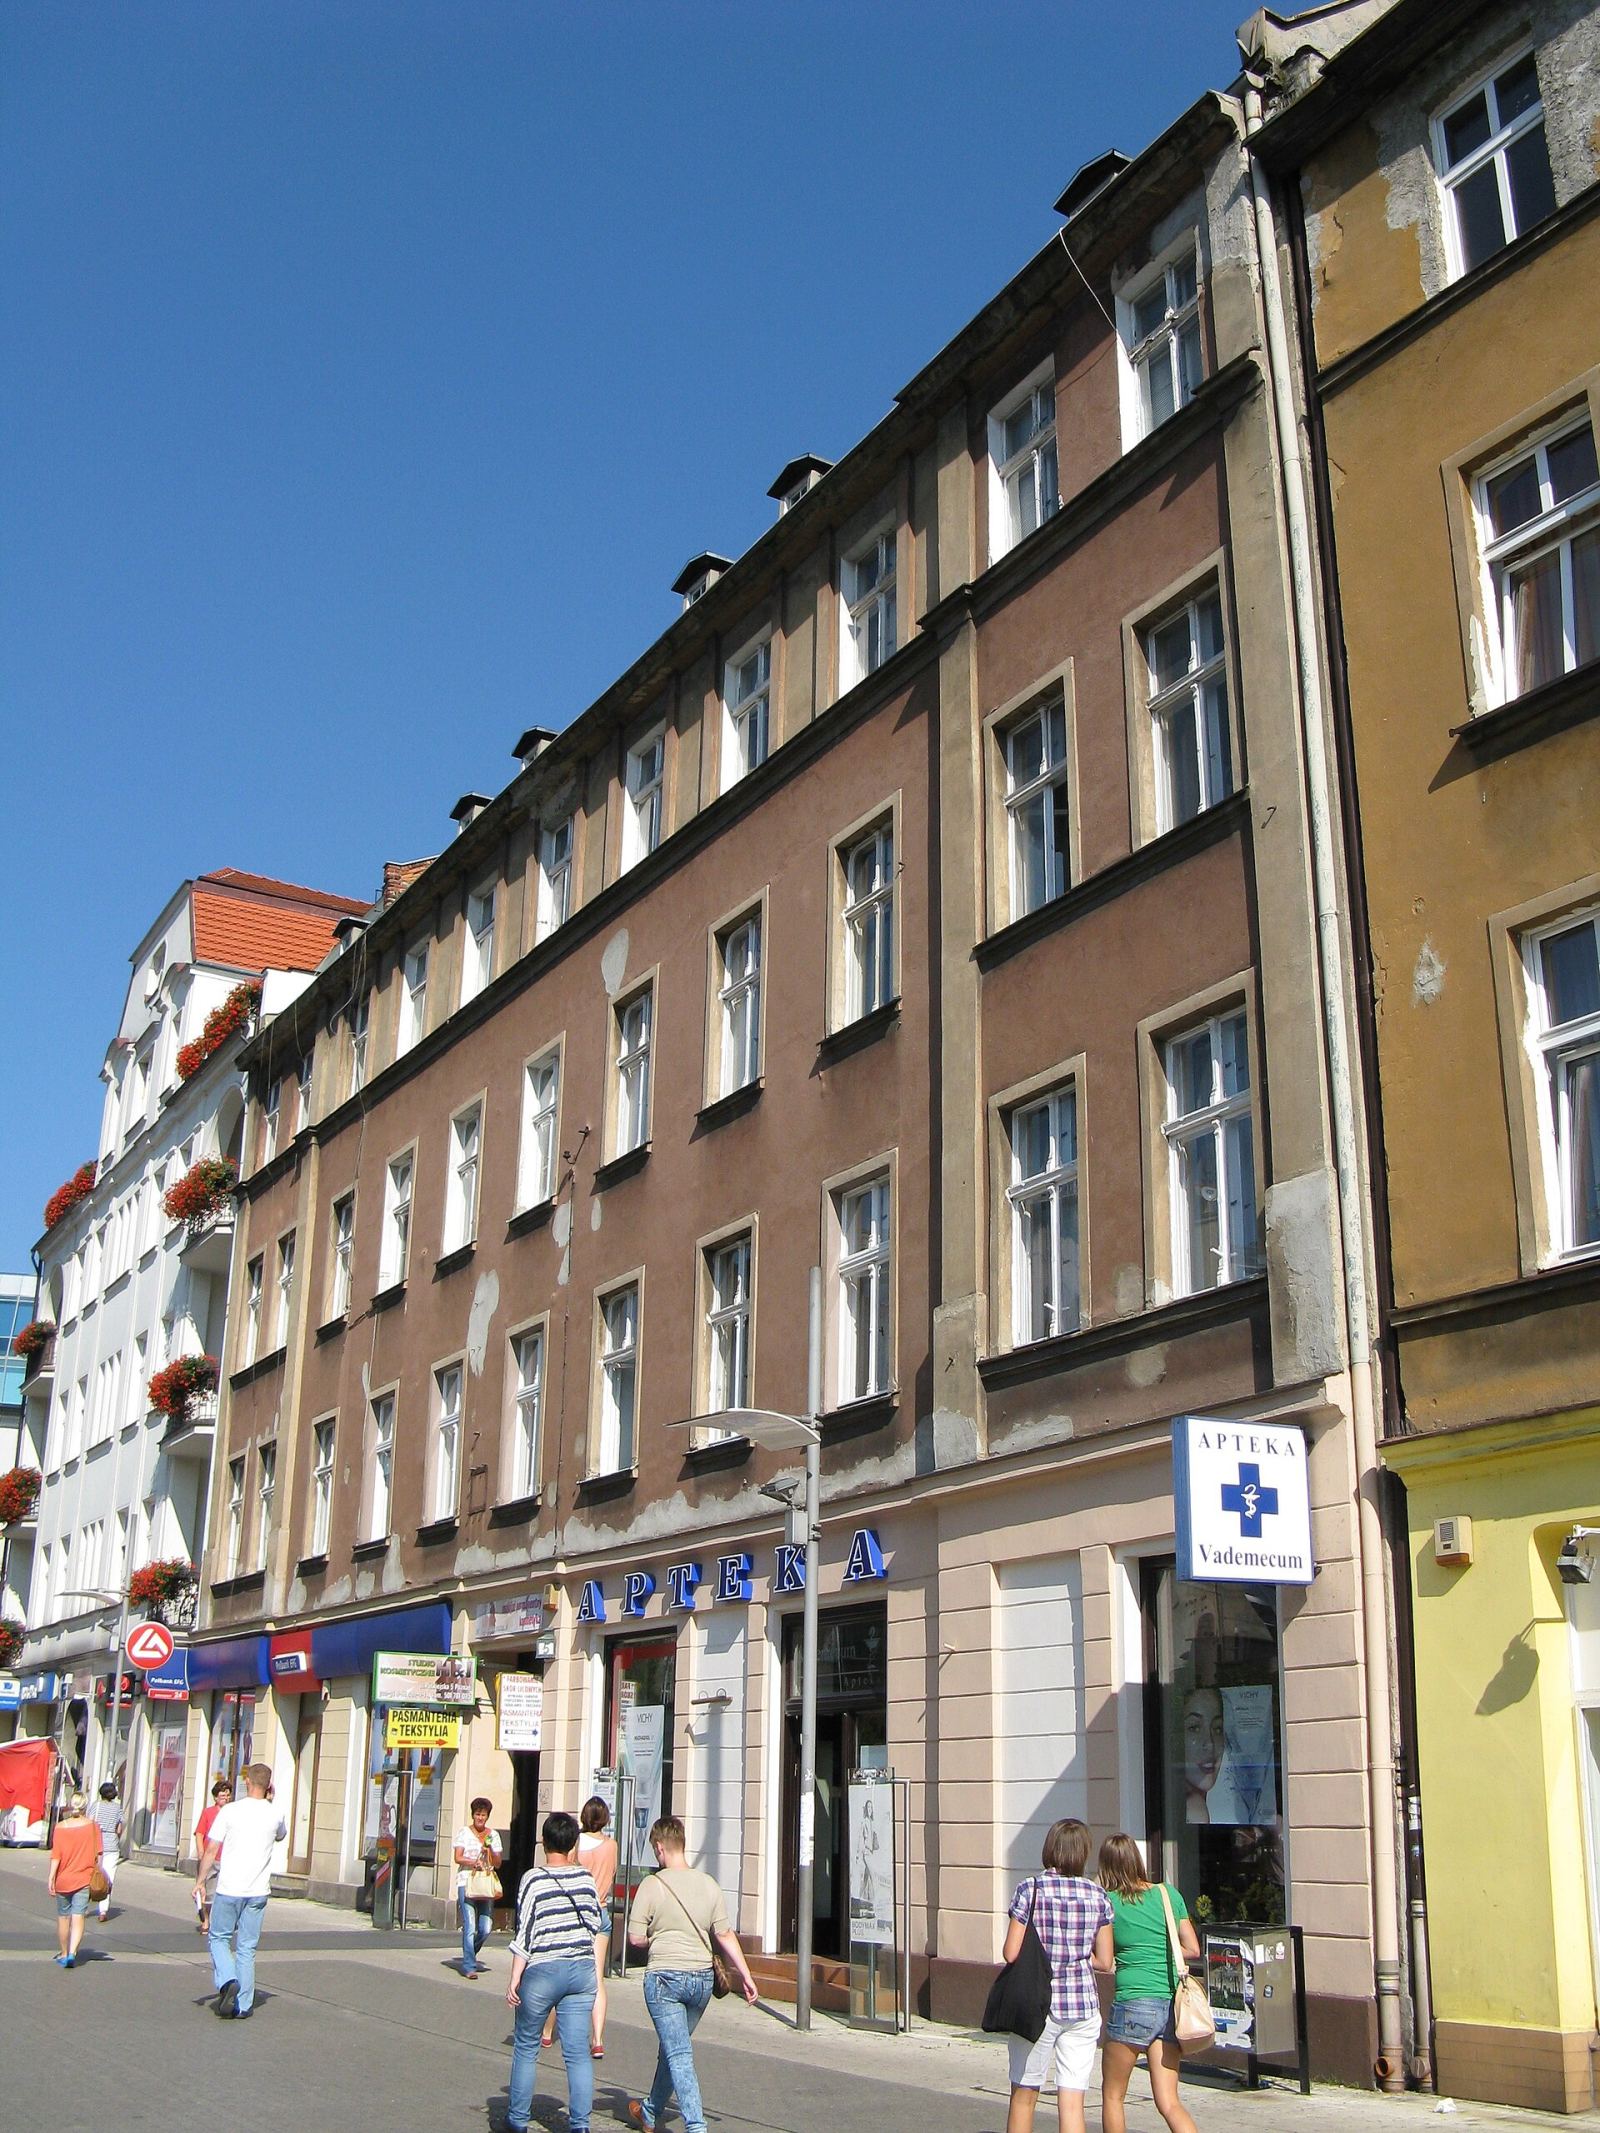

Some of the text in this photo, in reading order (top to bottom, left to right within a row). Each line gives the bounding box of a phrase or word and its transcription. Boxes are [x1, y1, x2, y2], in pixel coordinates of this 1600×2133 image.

[1199, 1432, 1296, 1457] APTEKA
[1199, 1544, 1303, 1569] Vademecum
[577, 1528, 885, 1622] APTEKA
[408, 1660, 436, 1668] STUDIO
[380, 1667, 436, 1678] KOSMETYCZNE
[151, 1677, 173, 1685] Polbank
[1240, 1691, 1259, 1699] VICHY
[392, 1710, 457, 1724] PASMANTERIA
[636, 1712, 653, 1723] VICHY
[502, 1719, 539, 1728] TEKSTYLIA
[400, 1724, 448, 1737] TEKSTYLIA
